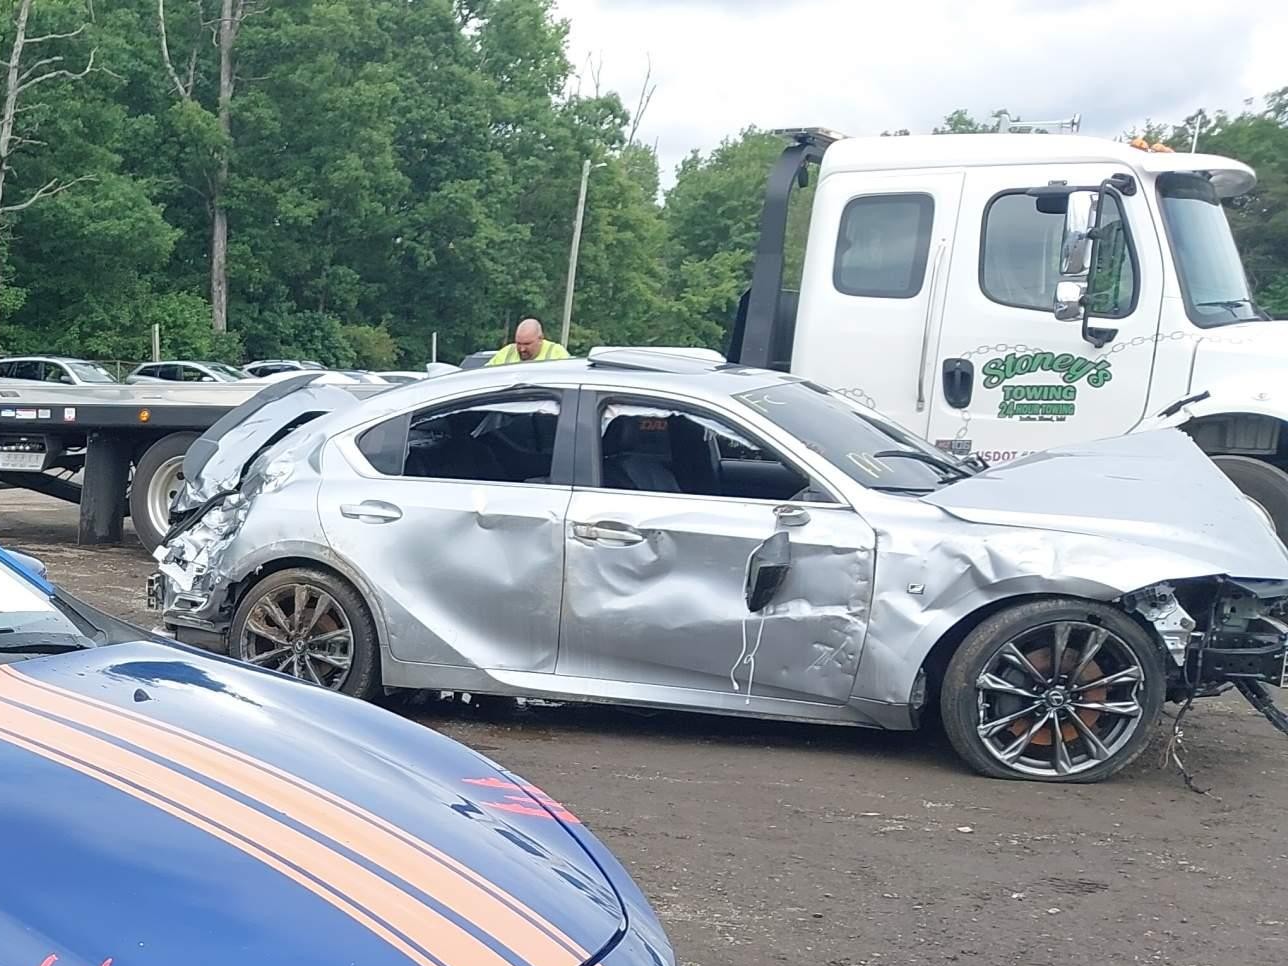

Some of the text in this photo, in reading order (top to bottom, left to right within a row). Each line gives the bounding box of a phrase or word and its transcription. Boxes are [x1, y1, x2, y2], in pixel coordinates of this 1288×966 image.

[982, 352, 1112, 389] Stoney's
[1002, 385, 1077, 401] TOWING
[997, 401, 1015, 418] 24
